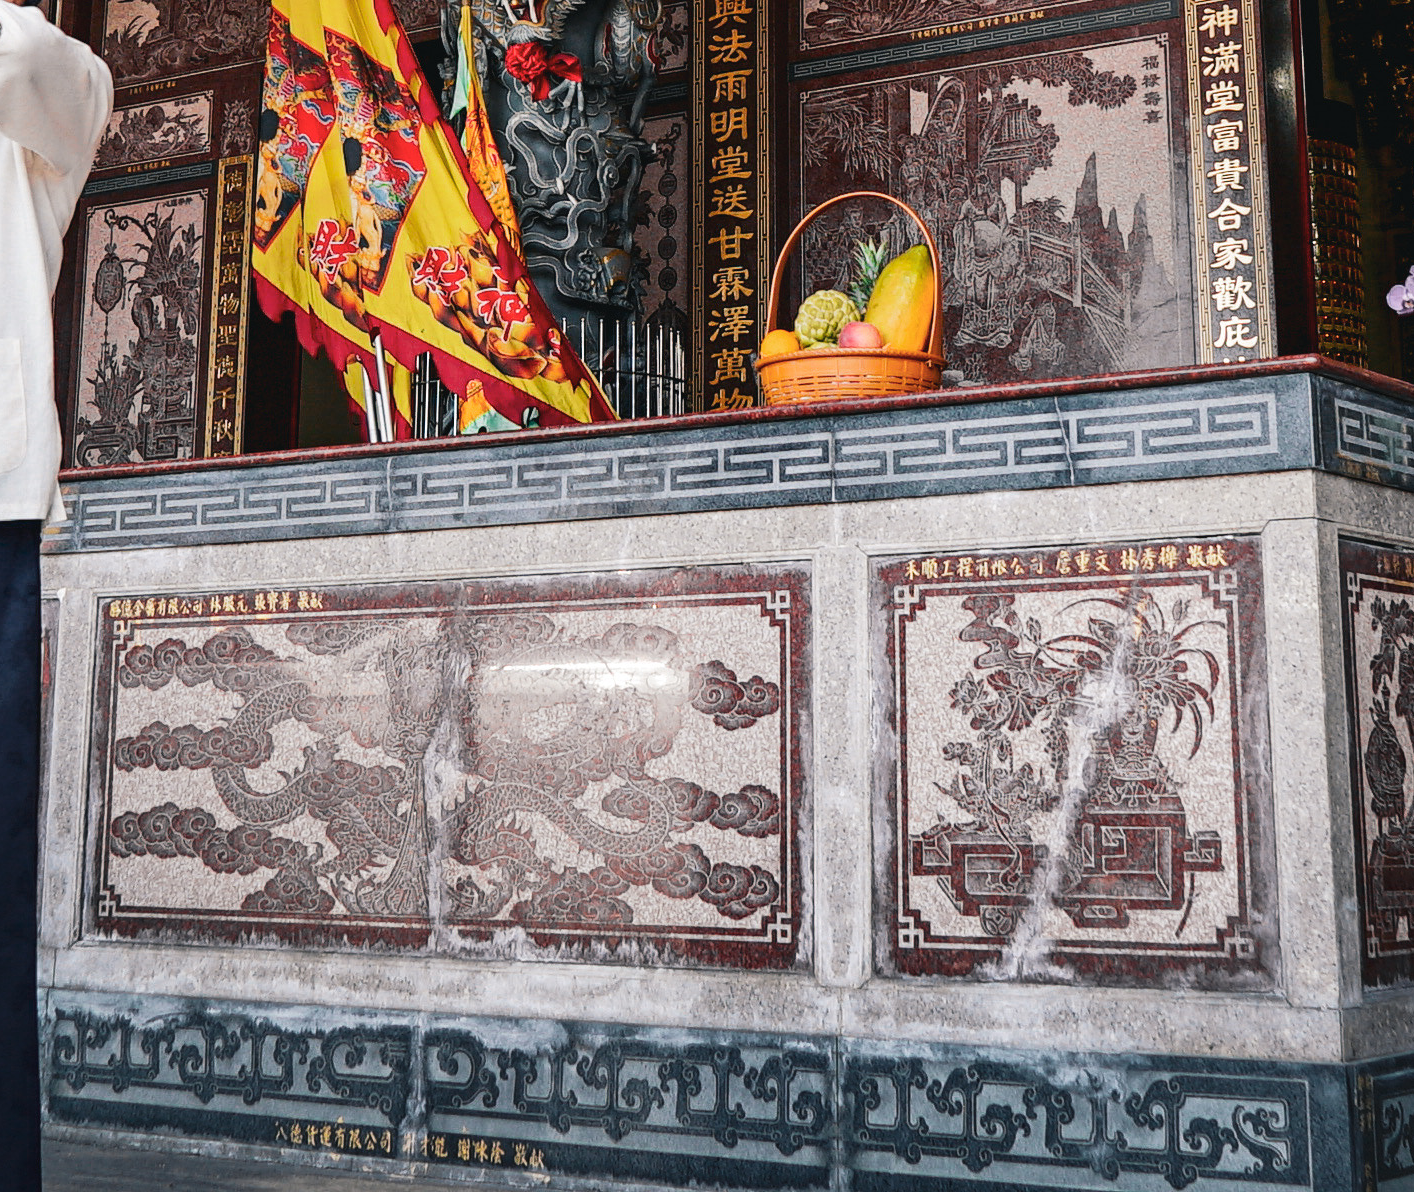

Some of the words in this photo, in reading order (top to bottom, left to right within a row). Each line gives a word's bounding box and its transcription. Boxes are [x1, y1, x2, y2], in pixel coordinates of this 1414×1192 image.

[1141, 55, 1164, 124] 福祿壽喜
[1198, 3, 1259, 364] 神滿堂富貴合家歡庇
